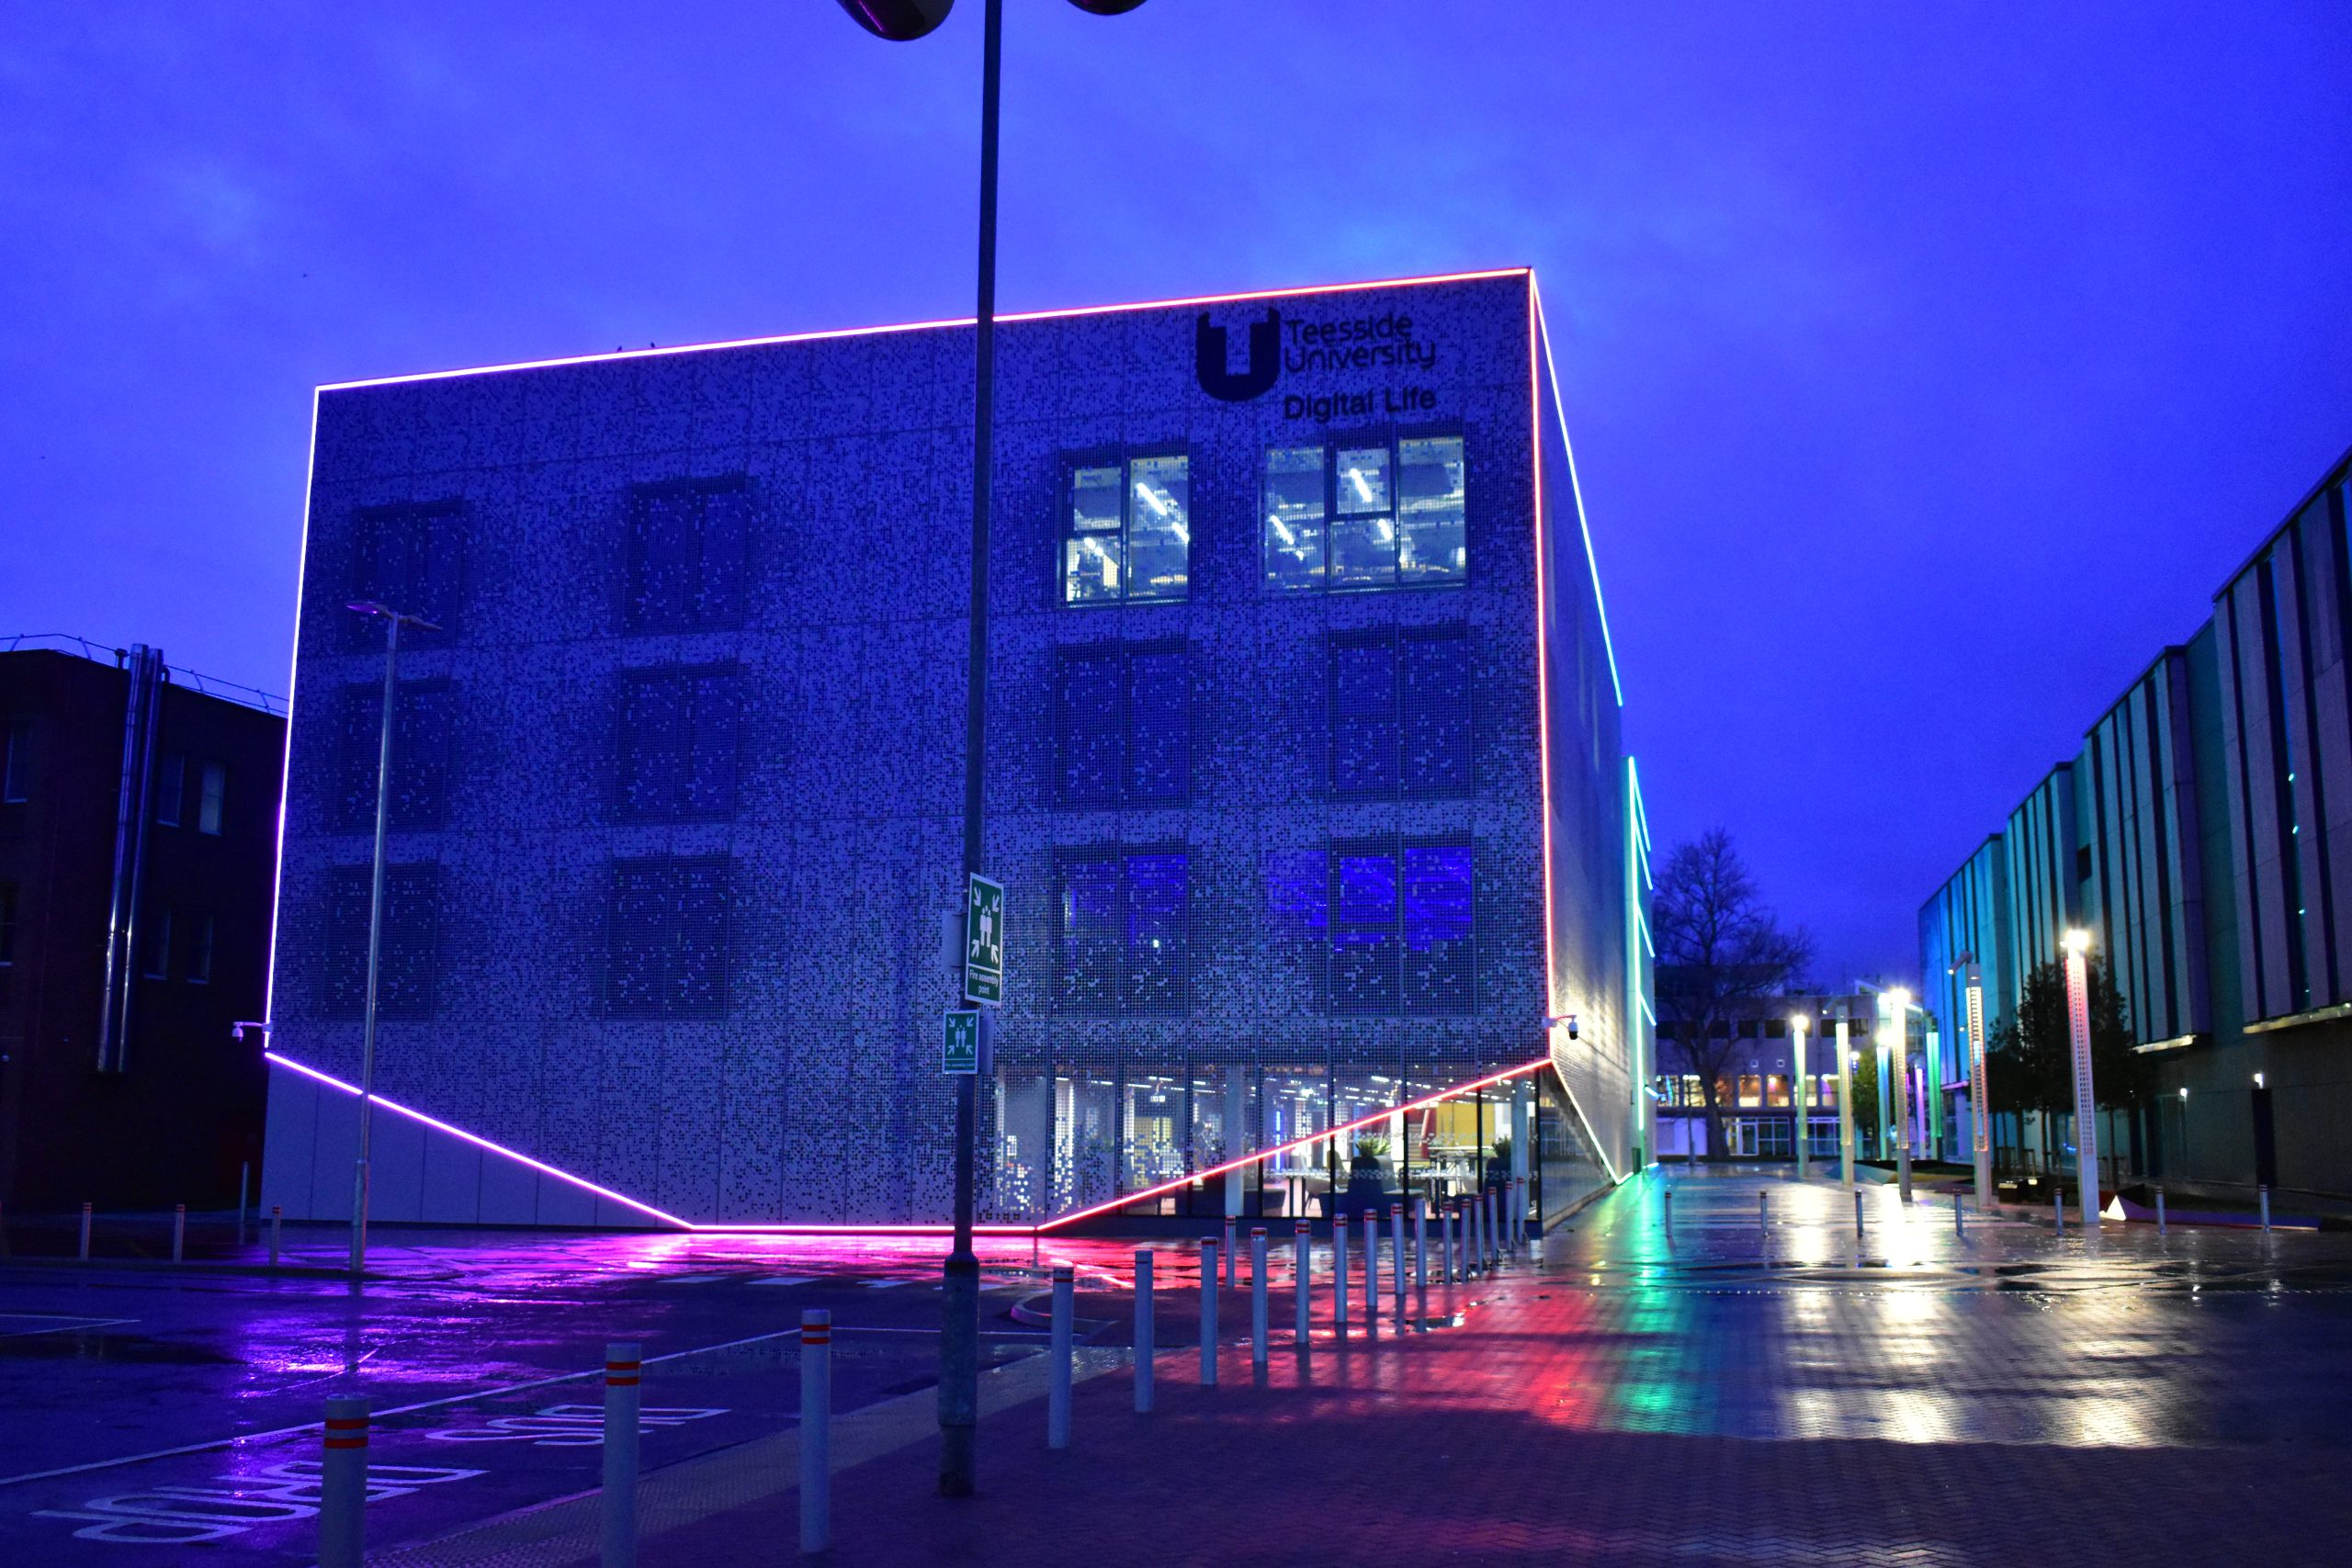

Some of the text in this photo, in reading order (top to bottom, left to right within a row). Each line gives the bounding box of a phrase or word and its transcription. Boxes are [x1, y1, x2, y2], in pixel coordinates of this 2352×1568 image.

[1287, 312, 1412, 345] Teesside
[1286, 339, 1436, 373] University
[1285, 386, 1436, 423] Digital Life
[969, 968, 999, 987] Fire assembly
[978, 985, 990, 995] point
